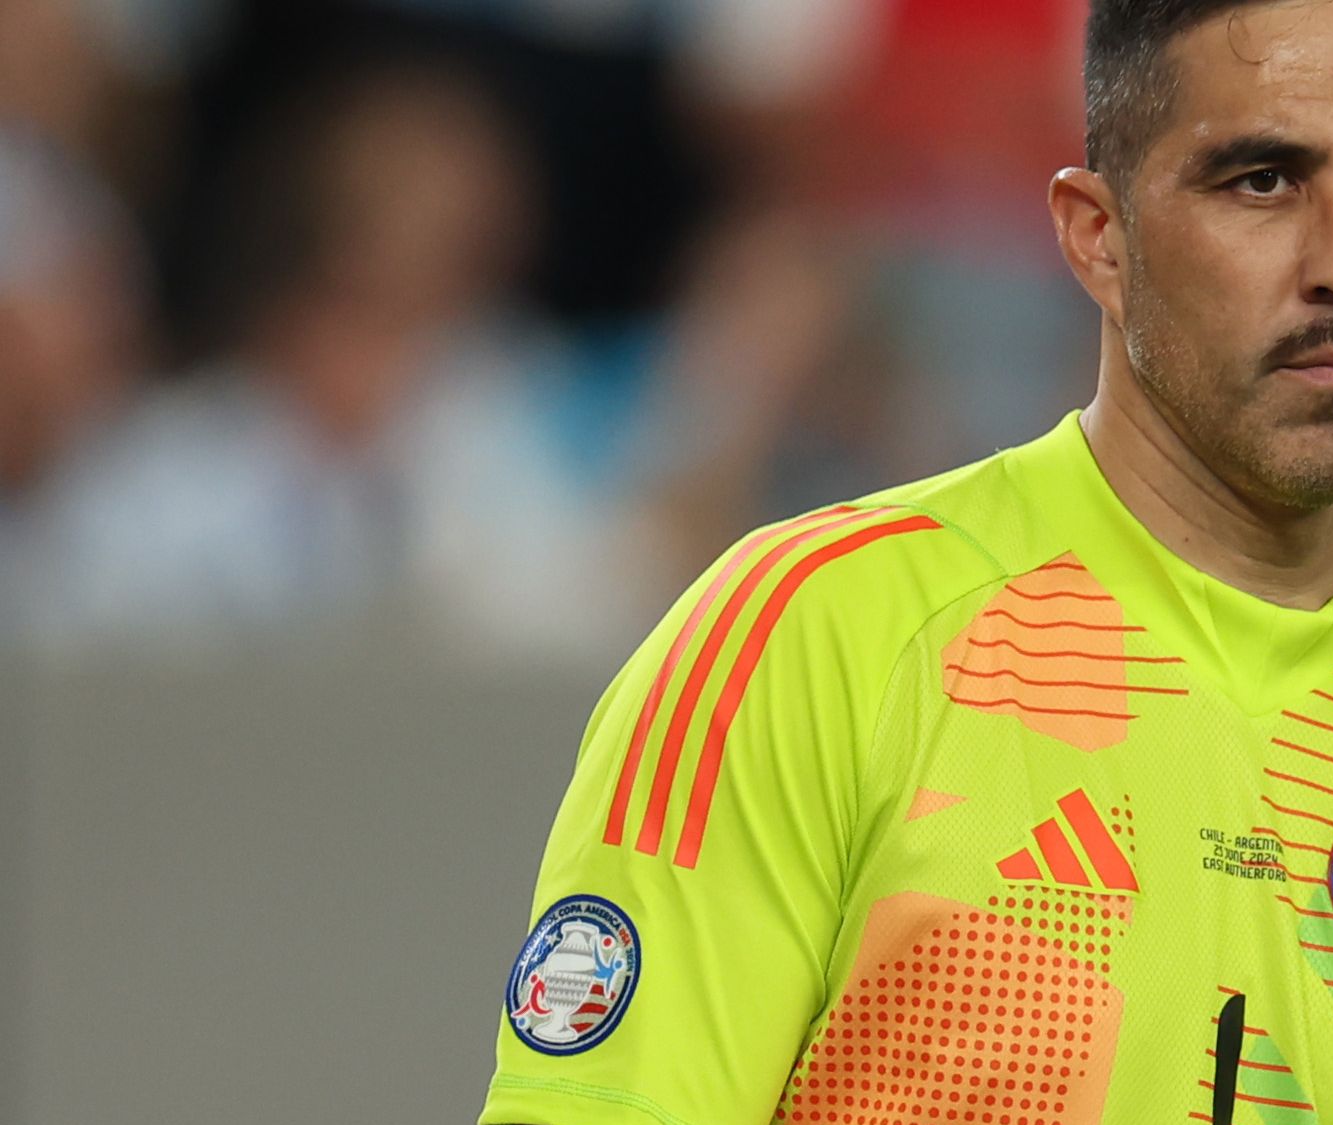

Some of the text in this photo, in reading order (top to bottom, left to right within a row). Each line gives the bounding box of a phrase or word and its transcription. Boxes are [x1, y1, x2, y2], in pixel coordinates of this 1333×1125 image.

[1199, 828, 1225, 844] CHILE
[1202, 857, 1224, 872] EAST
[1225, 847, 1245, 863] JUNE
[1248, 852, 1279, 866] 2024
[558, 904, 582, 917] COPA
[584, 905, 621, 931] AMERICA
